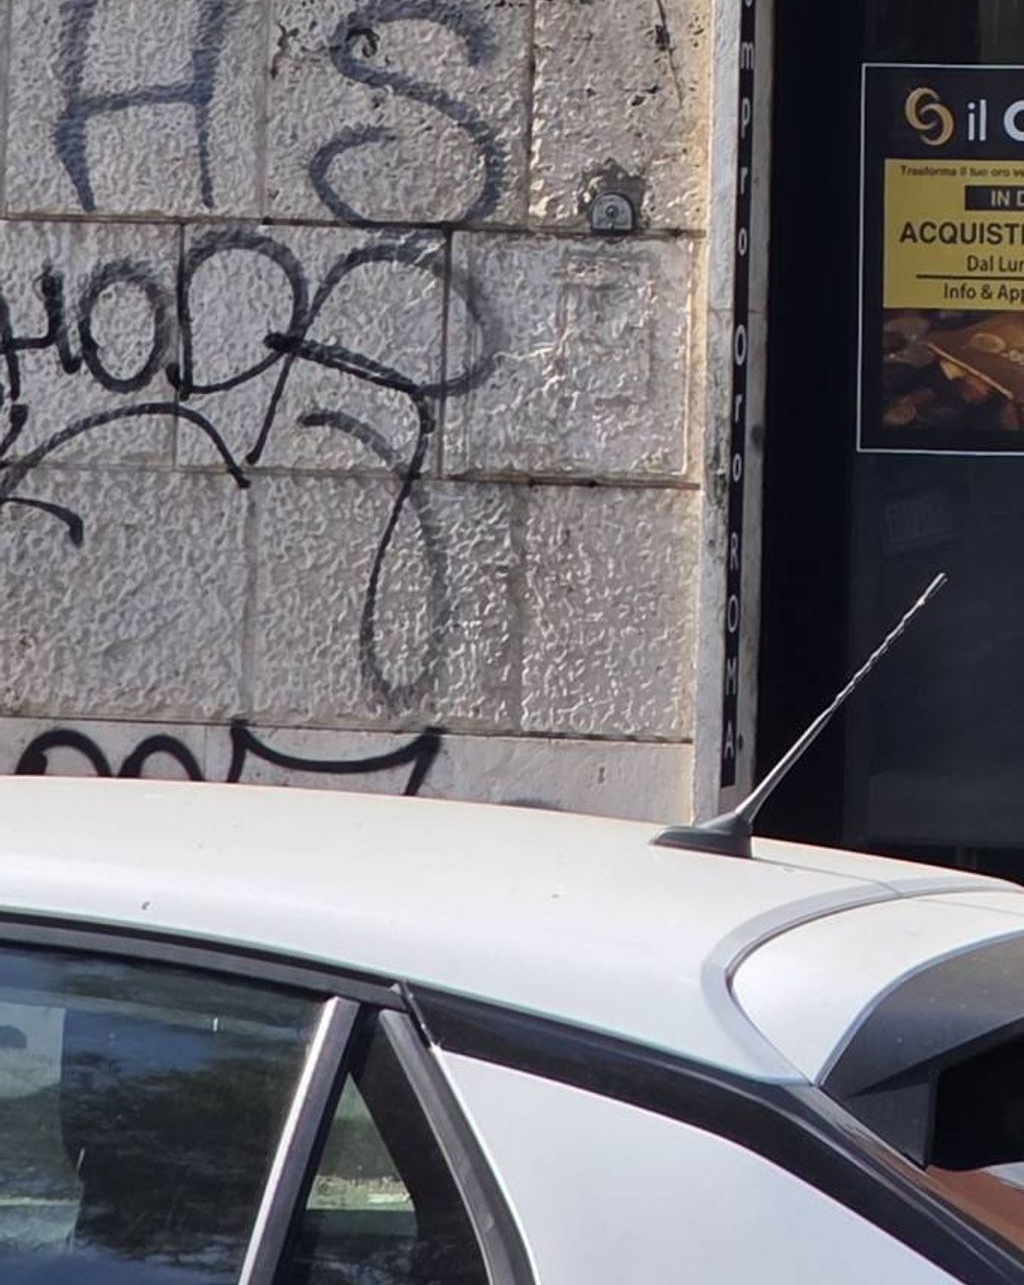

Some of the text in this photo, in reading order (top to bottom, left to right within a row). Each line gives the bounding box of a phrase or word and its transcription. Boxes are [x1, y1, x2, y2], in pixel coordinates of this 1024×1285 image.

[967, 98, 987, 141] il
[900, 164, 957, 177] Trasforma
[969, 167, 988, 177] tuo
[990, 168, 1010, 178] oro
[990, 189, 1010, 207] IN
[966, 254, 994, 273] Dal
[943, 282, 977, 300] Info
[980, 284, 993, 300] &
